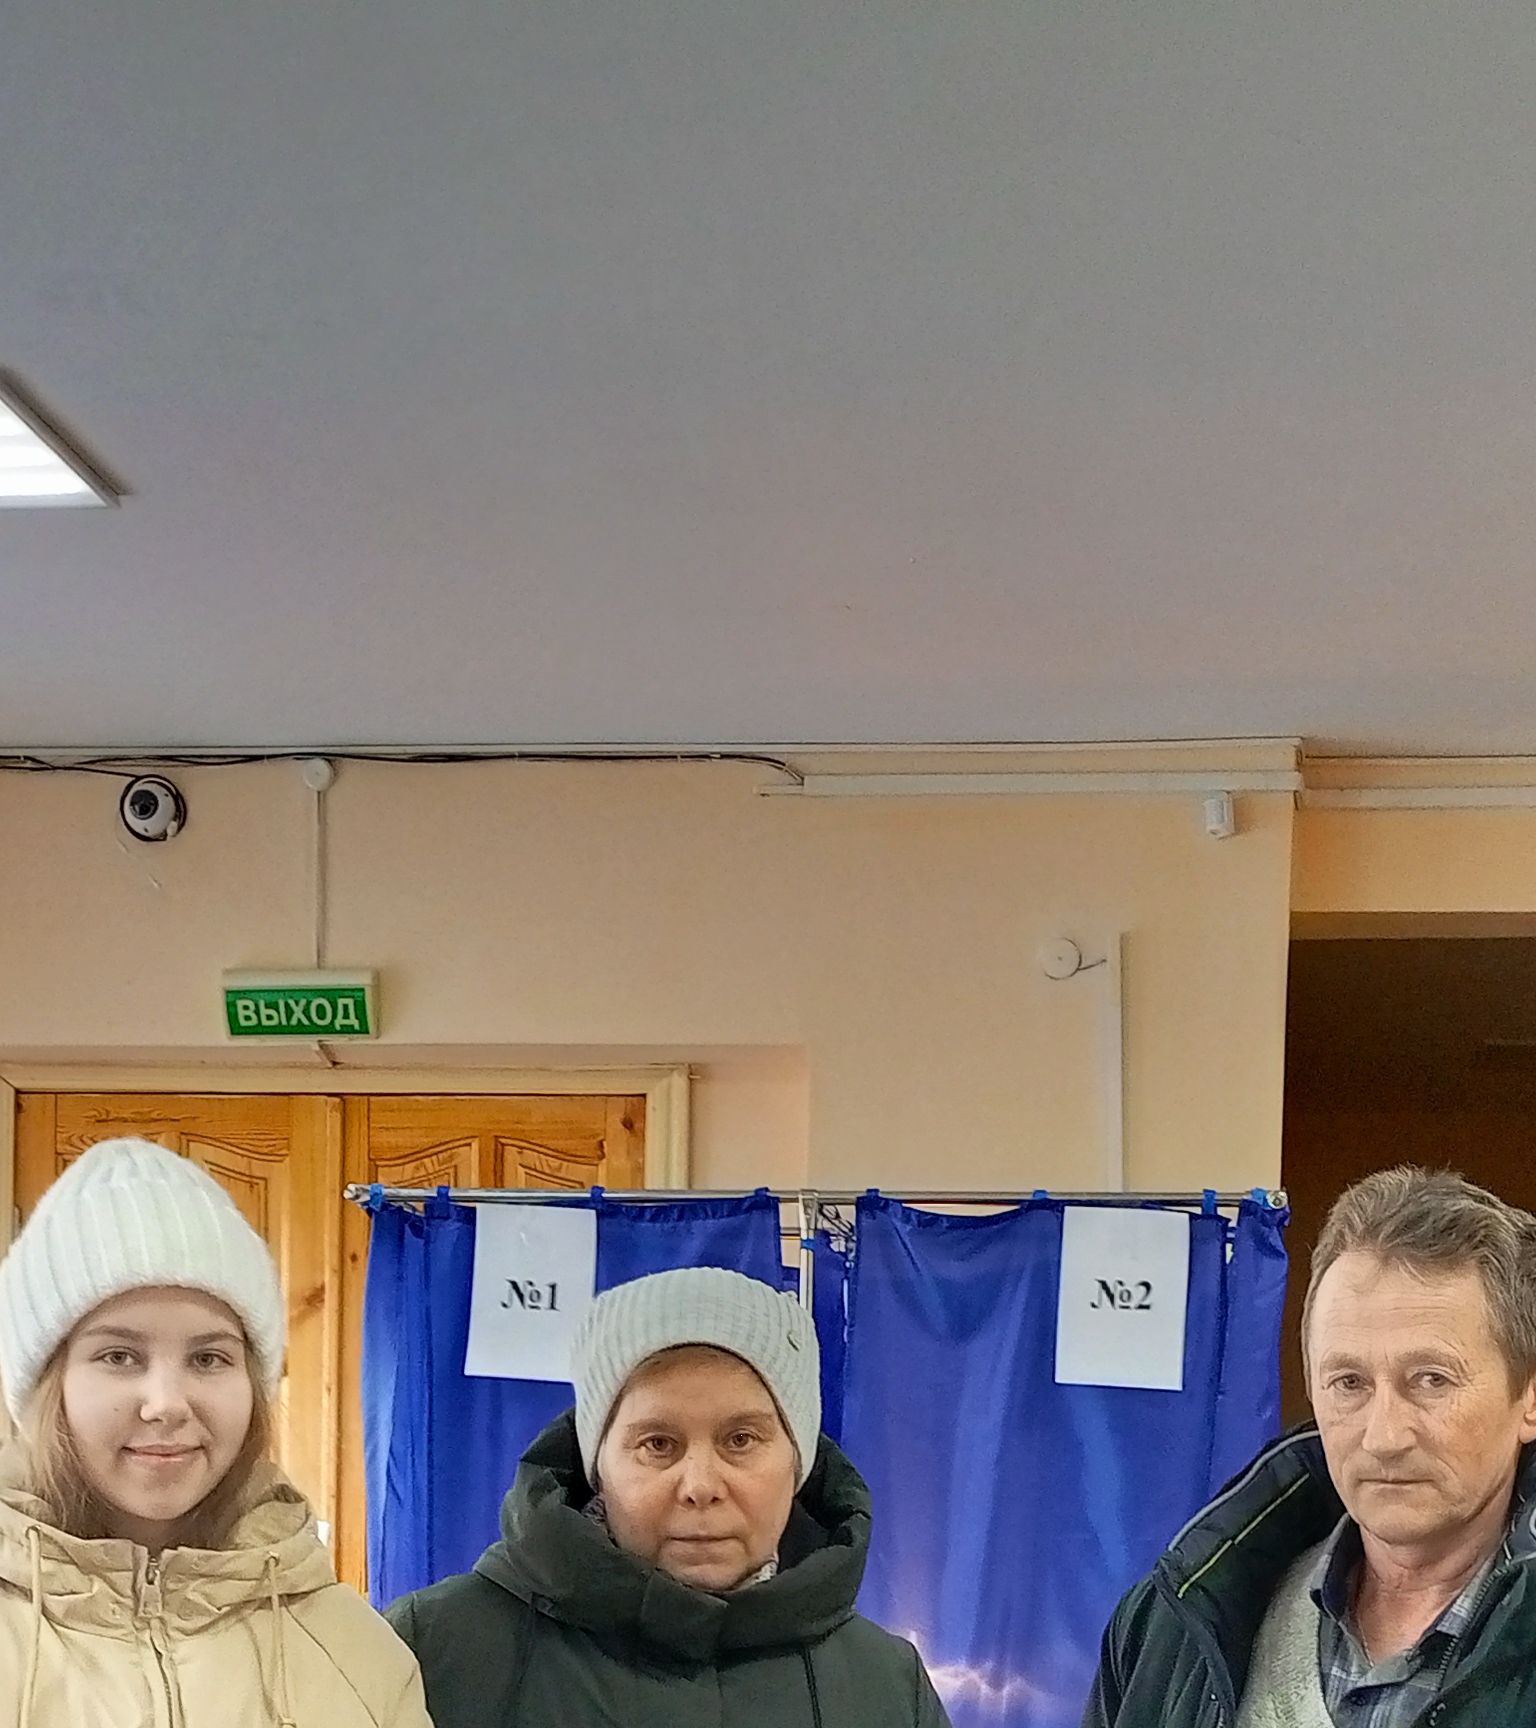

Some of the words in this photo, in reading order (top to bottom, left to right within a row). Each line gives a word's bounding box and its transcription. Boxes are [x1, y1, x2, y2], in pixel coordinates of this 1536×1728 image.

[235, 997, 360, 1031] ВЫХОД
[500, 1278, 561, 1312] №1
[1089, 1278, 1152, 1311] №2
